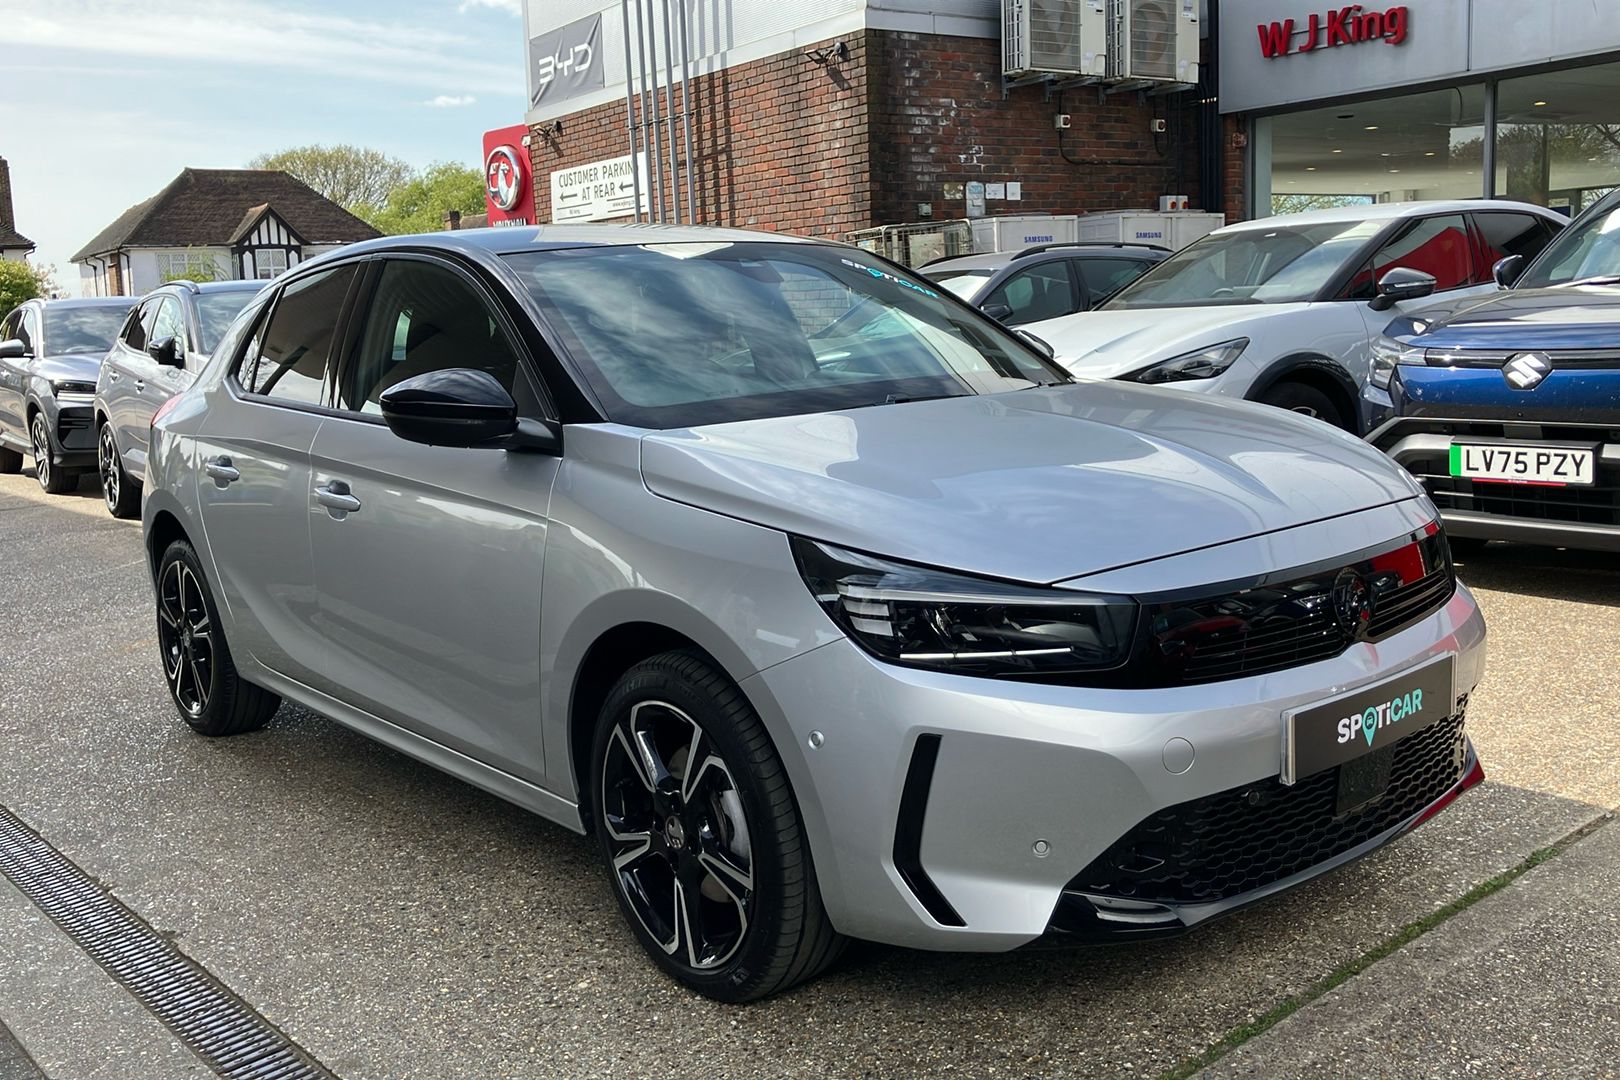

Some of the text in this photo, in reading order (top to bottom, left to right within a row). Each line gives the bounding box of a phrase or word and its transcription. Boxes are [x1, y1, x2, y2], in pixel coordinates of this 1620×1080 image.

[1257, 5, 1408, 58] W J King
[538, 43, 592, 84] BYD
[559, 160, 633, 188] CUSTOMER PARKIN
[582, 182, 616, 201] AT REAR
[1024, 235, 1053, 243] SAMSUNG
[1136, 231, 1162, 239] SAMSUNG
[1466, 449, 1586, 477] LV75 PZY
